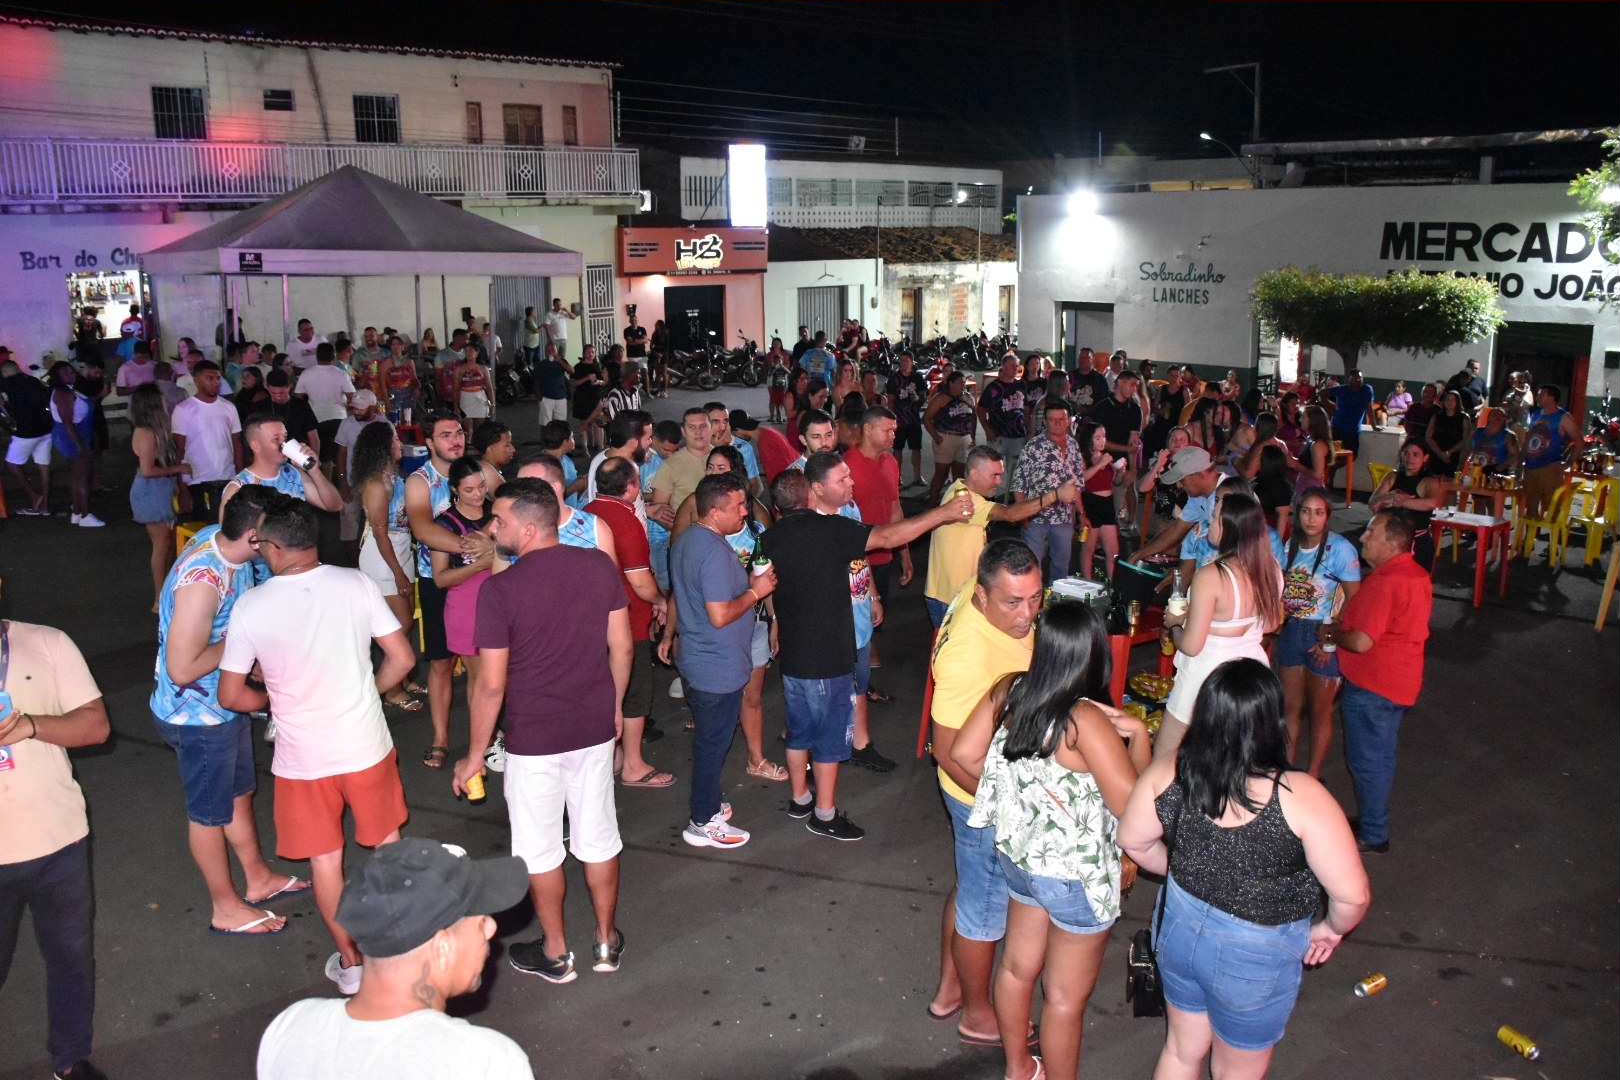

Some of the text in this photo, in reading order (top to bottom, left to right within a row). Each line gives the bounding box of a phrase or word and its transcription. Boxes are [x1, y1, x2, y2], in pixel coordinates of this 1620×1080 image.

[20, 251, 62, 270] Bar
[75, 249, 97, 267] do
[1139, 261, 1226, 284] Sobradinho
[1153, 287, 1210, 305] LANCHES
